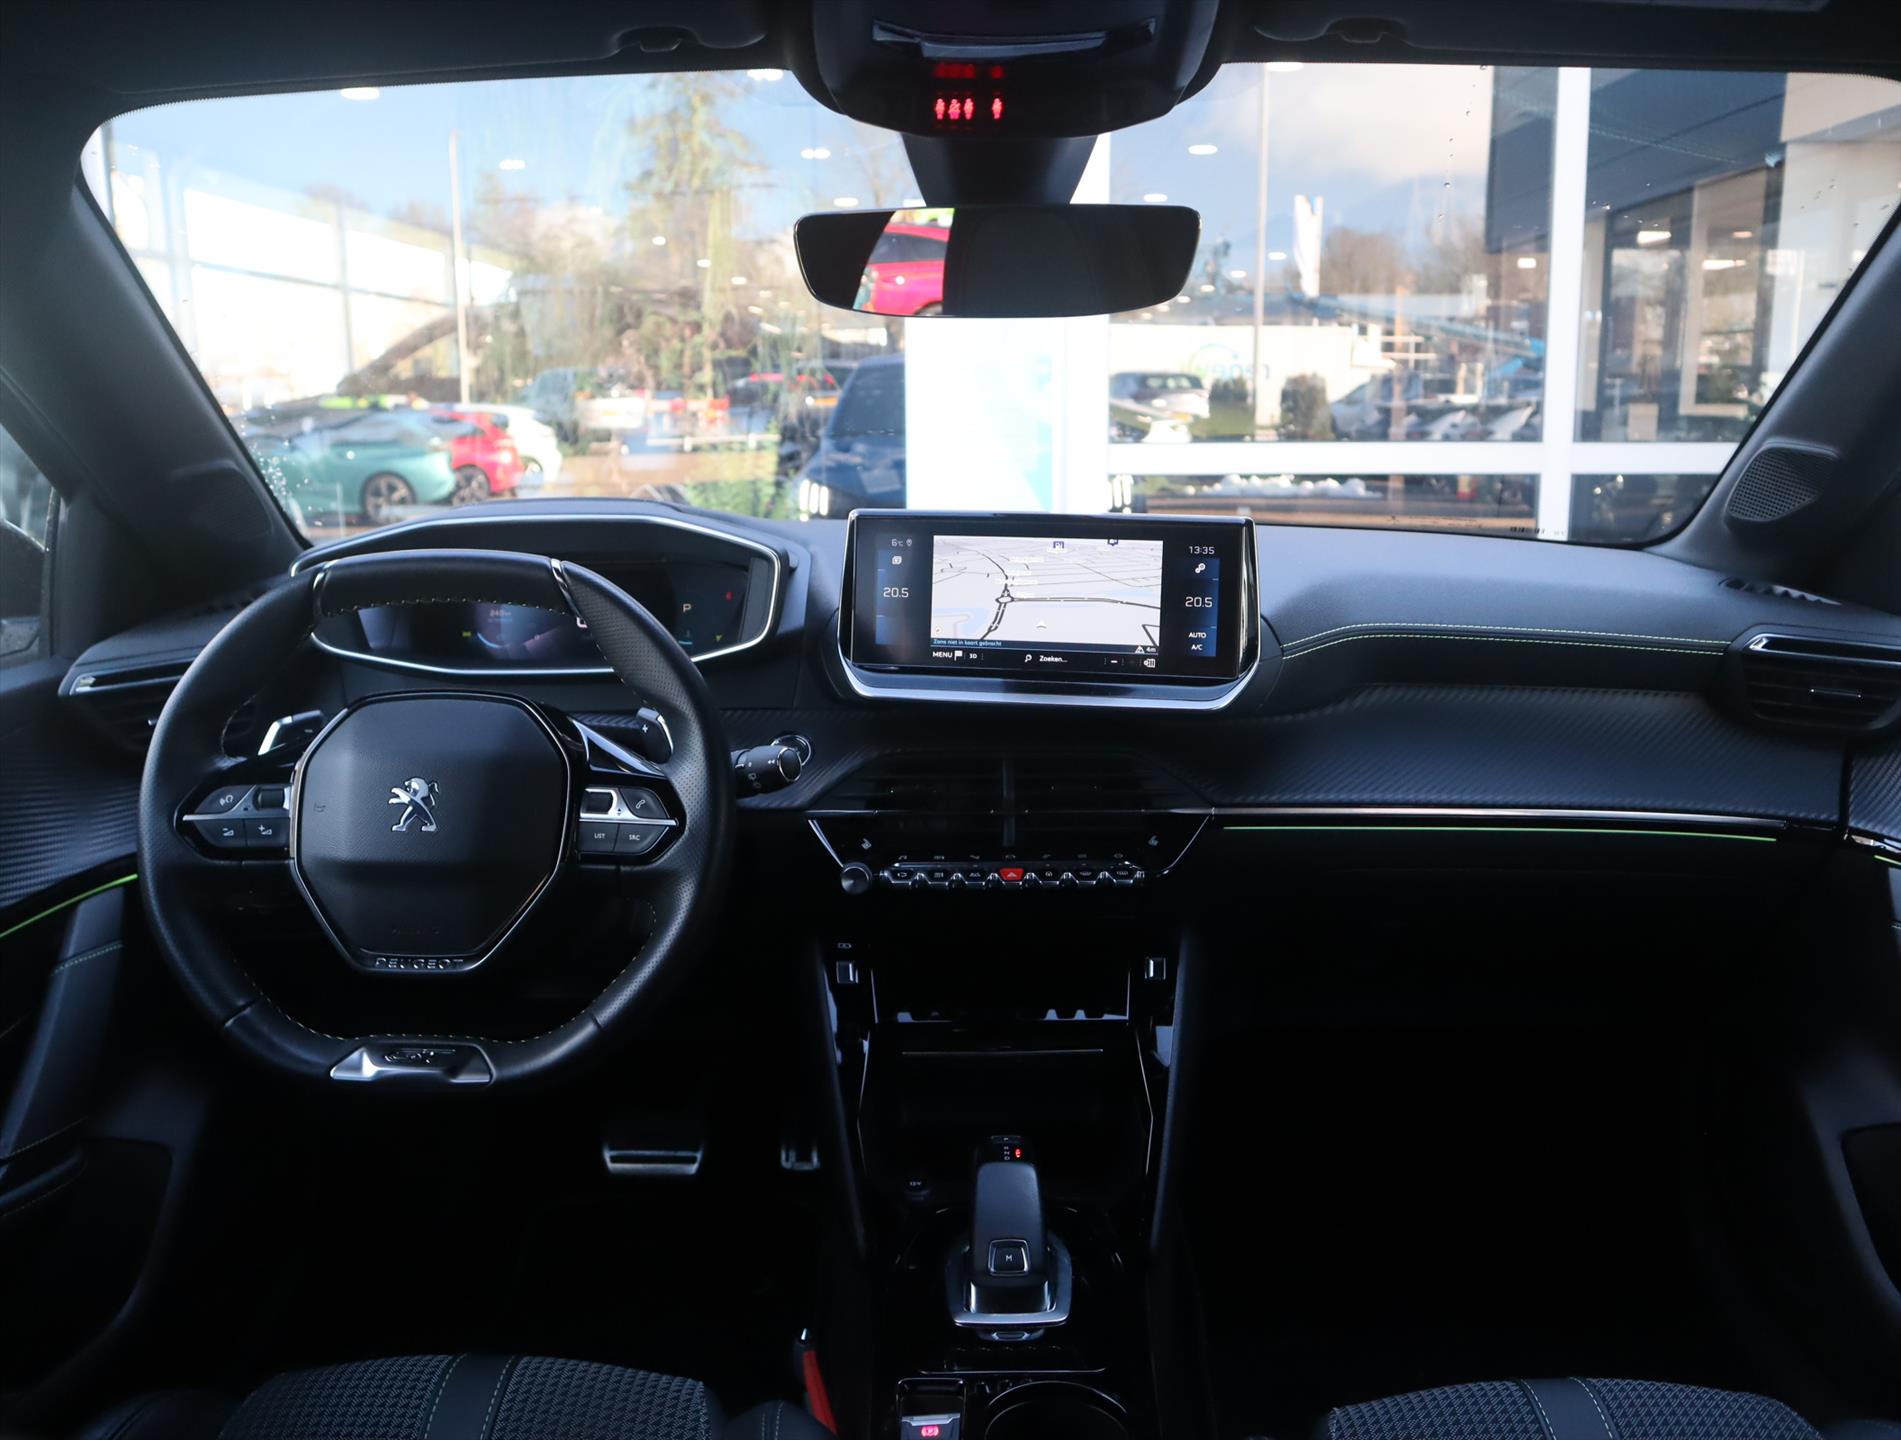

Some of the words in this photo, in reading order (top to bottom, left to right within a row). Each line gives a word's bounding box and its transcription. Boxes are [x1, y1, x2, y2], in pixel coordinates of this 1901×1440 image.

[1188, 546, 1215, 555] 13:35
[883, 587, 909, 598] 20.5
[1185, 596, 1213, 608] 20.5
[682, 603, 692, 613] P
[375, 957, 464, 969] PEUGEOT
[1005, 1254, 1013, 1262] M
